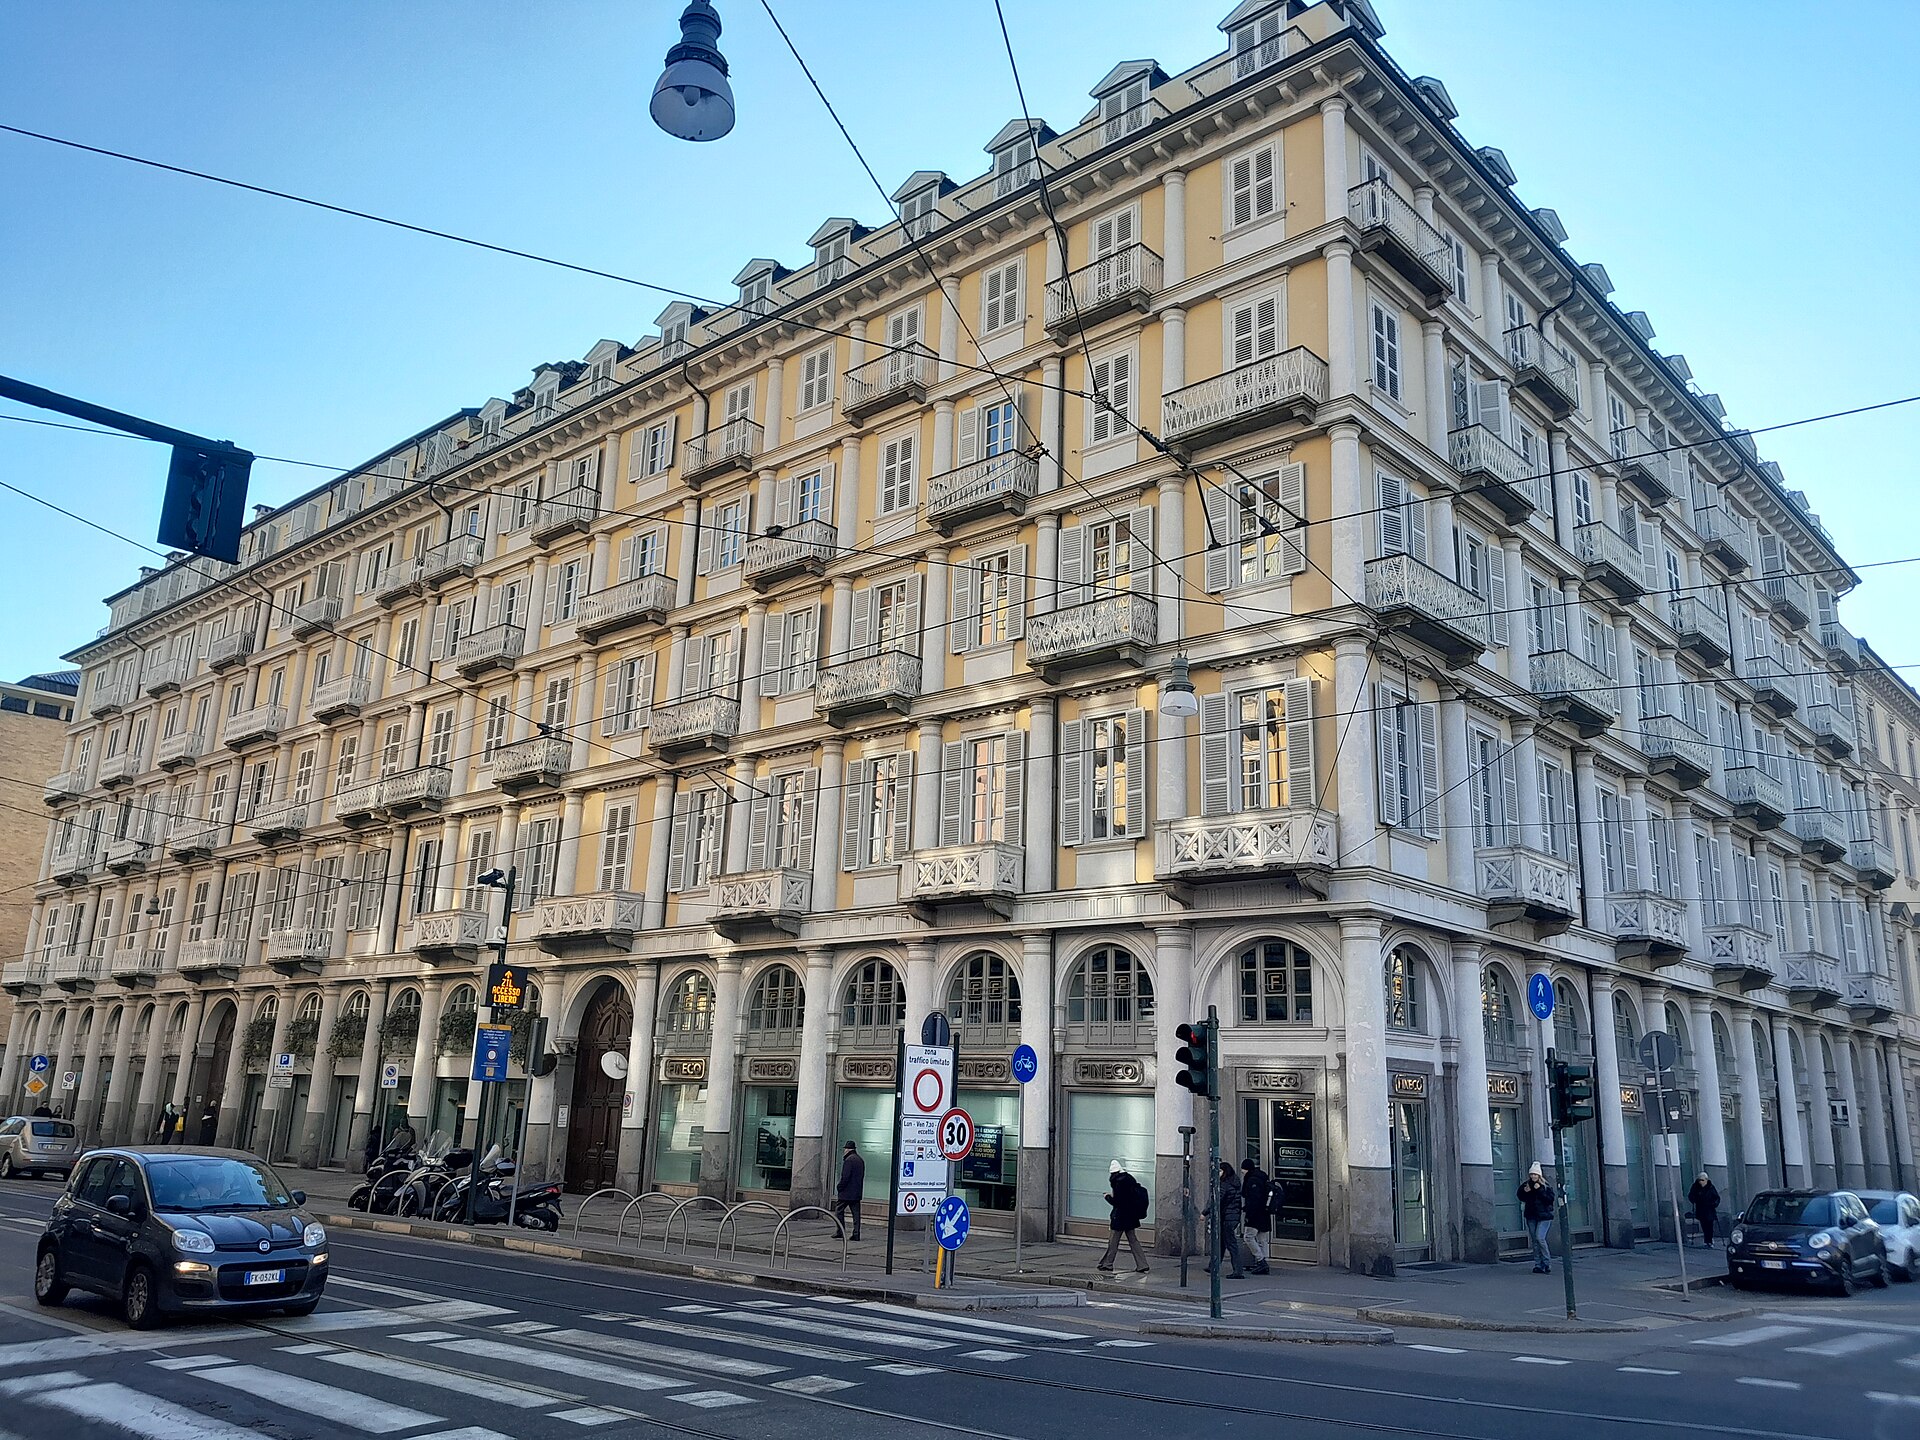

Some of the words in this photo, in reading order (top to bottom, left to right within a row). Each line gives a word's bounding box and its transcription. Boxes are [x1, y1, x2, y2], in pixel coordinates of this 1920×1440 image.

[492, 986, 521, 997] ACCESSO
[493, 994, 518, 1004] LIBERO
[909, 1056, 929, 1065] traffico
[930, 1058, 950, 1066] limitato
[669, 1062, 702, 1075] FINECO
[753, 1062, 792, 1076] FINECO
[847, 1062, 892, 1077] FINECO
[1079, 1062, 1138, 1080] FINECO
[1251, 1073, 1298, 1087] FINECO
[946, 1122, 967, 1146] 30
[906, 1198, 915, 1207] 30
[931, 1197, 941, 1207] 24
